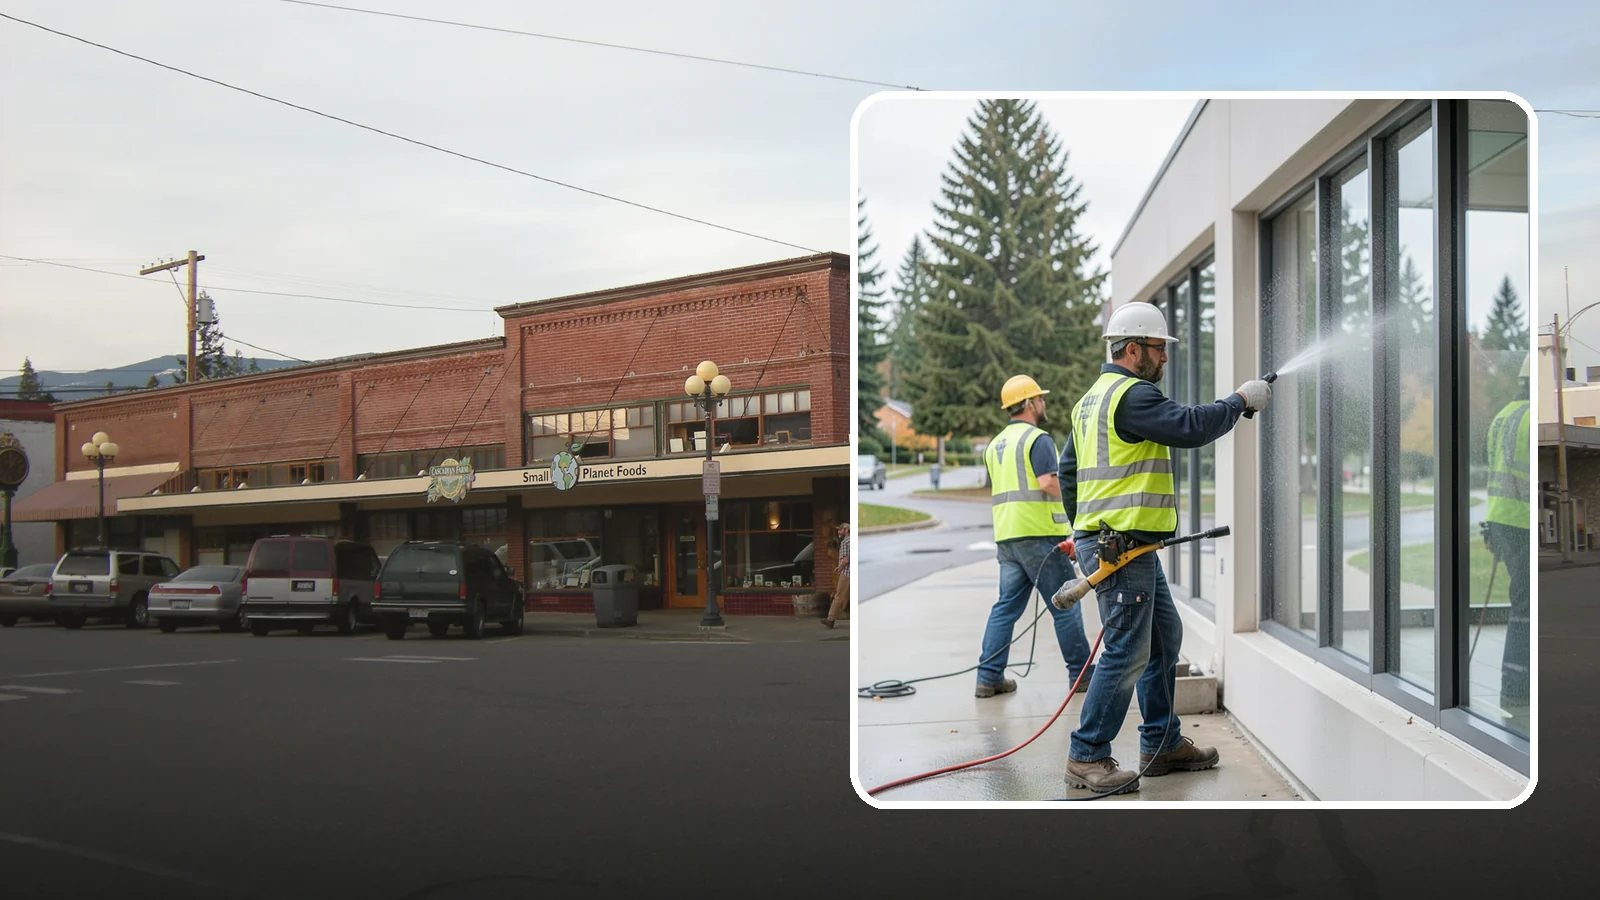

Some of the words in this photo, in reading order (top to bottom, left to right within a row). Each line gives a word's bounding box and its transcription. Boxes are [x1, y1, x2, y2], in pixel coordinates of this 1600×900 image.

[522, 471, 549, 483] Small
[582, 467, 614, 479] Planet
[616, 464, 647, 477] Foods
